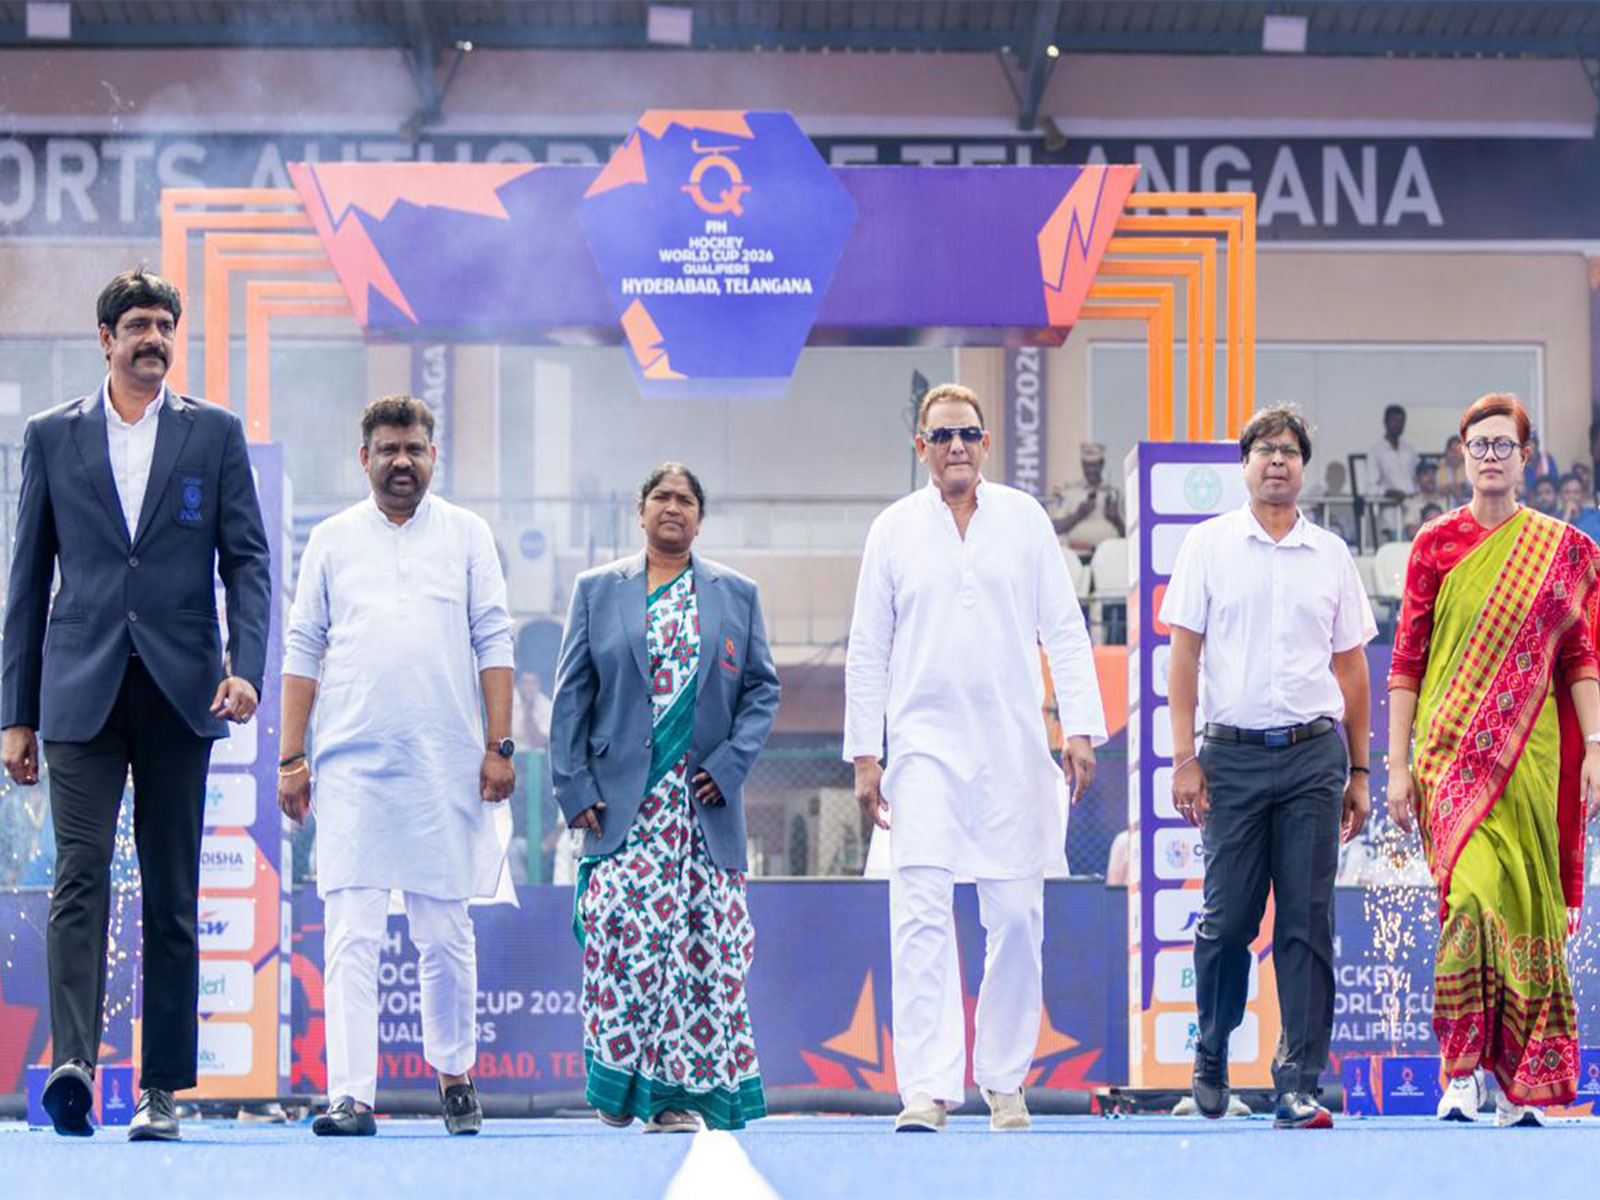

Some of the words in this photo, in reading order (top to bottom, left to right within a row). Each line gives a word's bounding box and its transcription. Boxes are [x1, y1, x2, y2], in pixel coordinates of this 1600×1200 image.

[705, 220, 728, 235] FIH
[688, 236, 744, 250] HOCKEY
[658, 249, 710, 263] WORLD
[711, 249, 740, 263] CUP
[741, 249, 774, 263] 2026
[682, 263, 751, 275] QUALIFIERS
[621, 277, 722, 296] HYDERABAD,
[724, 277, 813, 295] TELANGANA
[201, 854, 244, 867] DISHA
[198, 920, 229, 936] SW
[1334, 992, 1399, 1015] ORLD
[1405, 992, 1435, 1015] CU
